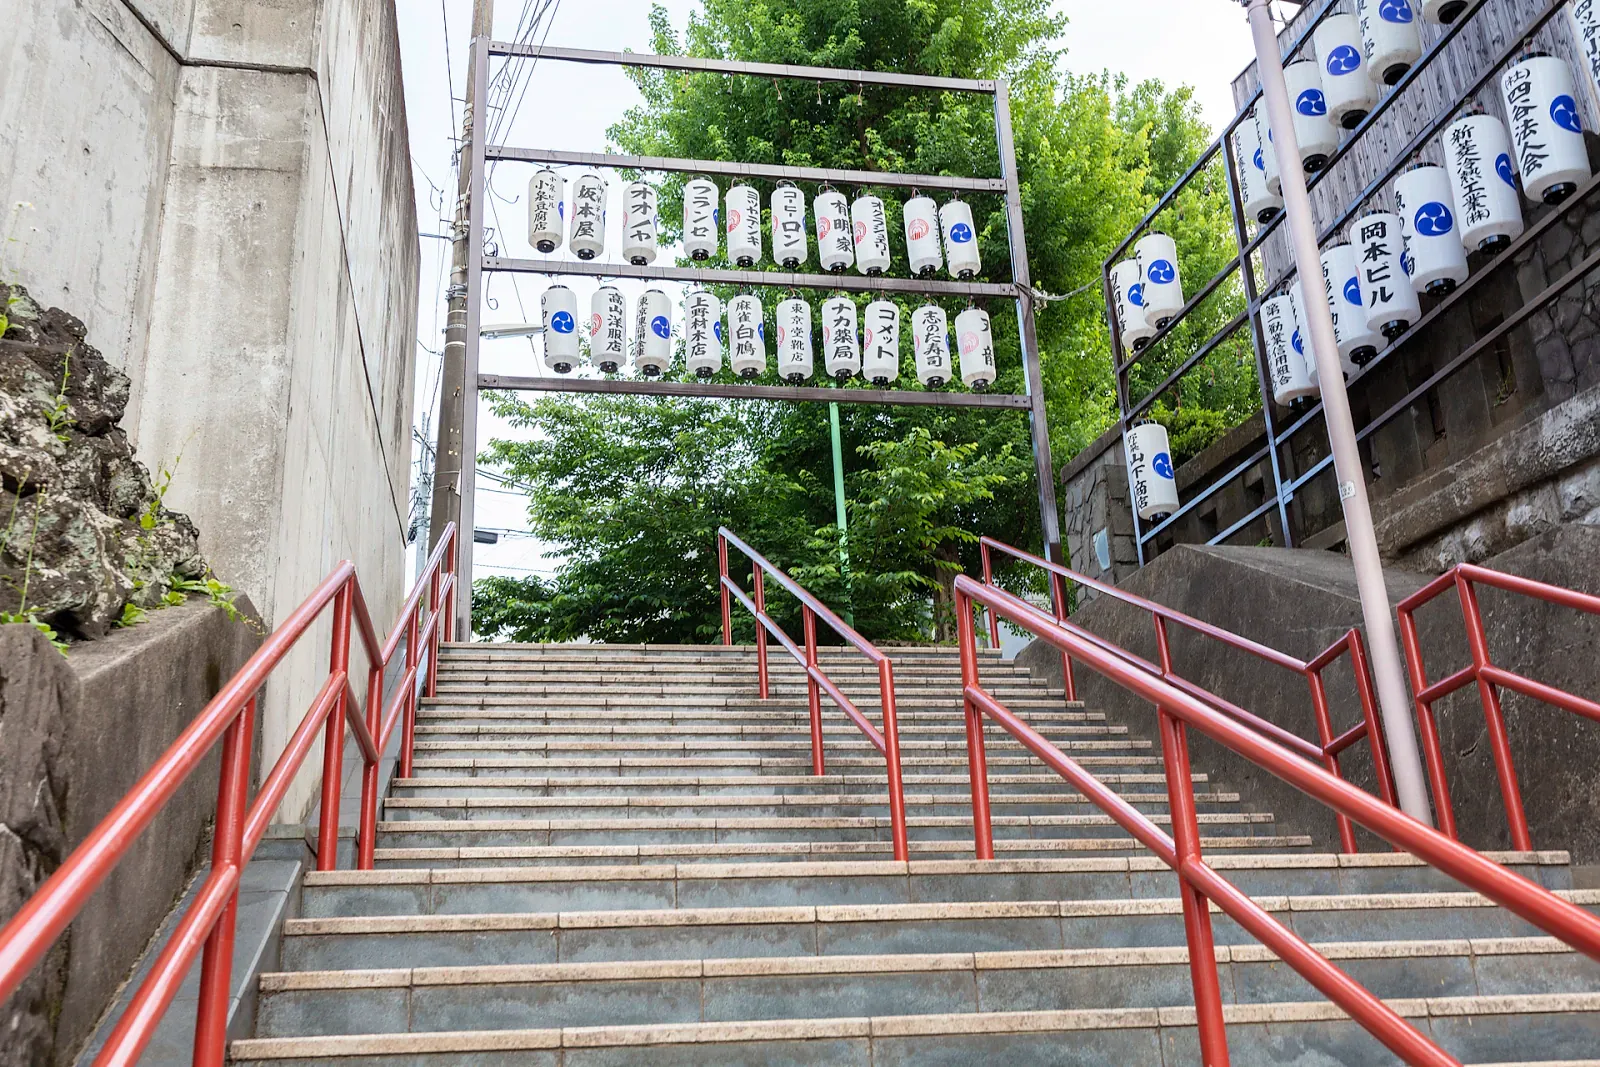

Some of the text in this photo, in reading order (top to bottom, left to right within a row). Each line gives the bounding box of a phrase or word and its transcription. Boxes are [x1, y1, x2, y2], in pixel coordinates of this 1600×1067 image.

[573, 185, 597, 239] 坂本屋
[630, 187, 653, 241] オオノヤ
[690, 185, 712, 237] フランセ
[831, 200, 852, 253] 有明家
[1360, 221, 1394, 309] 岡本ビル
[606, 292, 623, 353] 高山洋服店
[690, 296, 709, 358] 上野材木店
[790, 303, 804, 362] 東京堂靴店
[831, 303, 853, 360] ナカ薬局
[877, 309, 896, 360] コメット
[1265, 302, 1292, 386] 第一勧業信用組合
